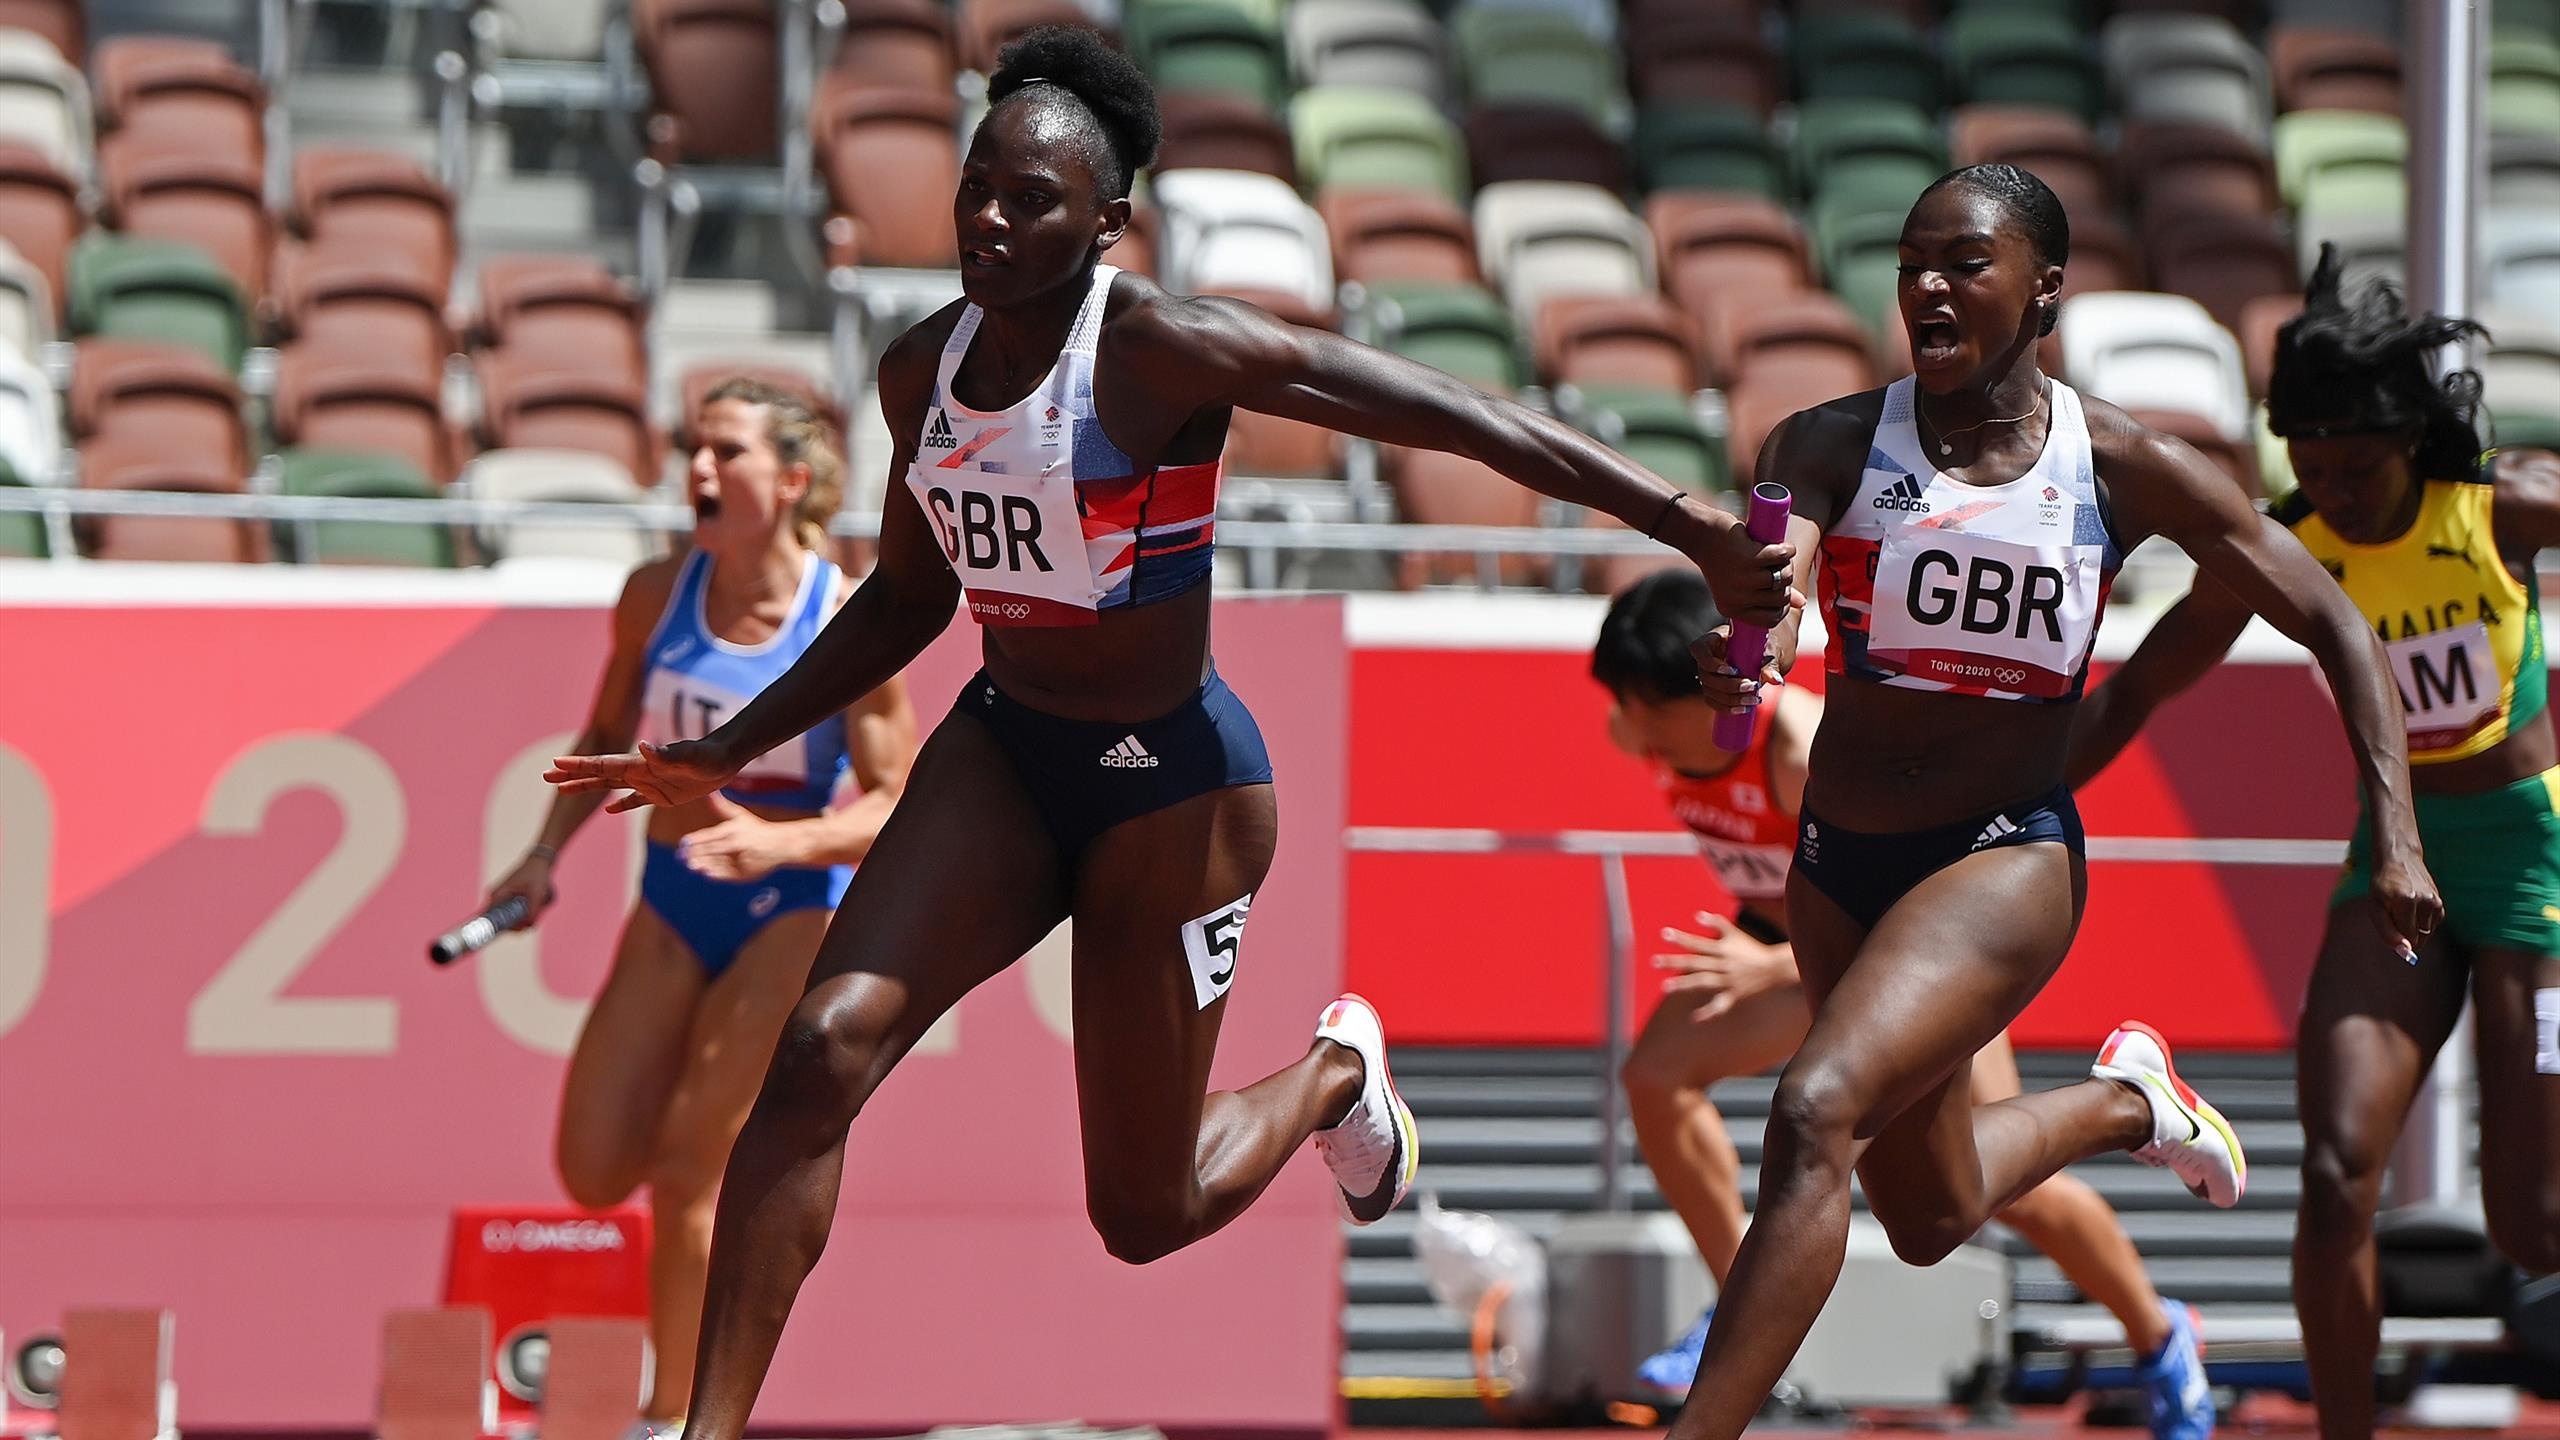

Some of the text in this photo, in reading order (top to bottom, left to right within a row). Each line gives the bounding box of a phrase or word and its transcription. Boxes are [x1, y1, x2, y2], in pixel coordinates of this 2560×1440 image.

[925, 433, 957, 449] adidas
[1873, 495, 1930, 514] adidas
[927, 487, 1055, 573] GBR
[1906, 549, 2064, 643] GBR
[981, 603, 1000, 615] 2020
[1930, 659, 1991, 677] TOKYO 2020
[1100, 753, 1158, 769] adidas
[1203, 911, 1238, 986] 5
[513, 1219, 626, 1251] OMEGA
